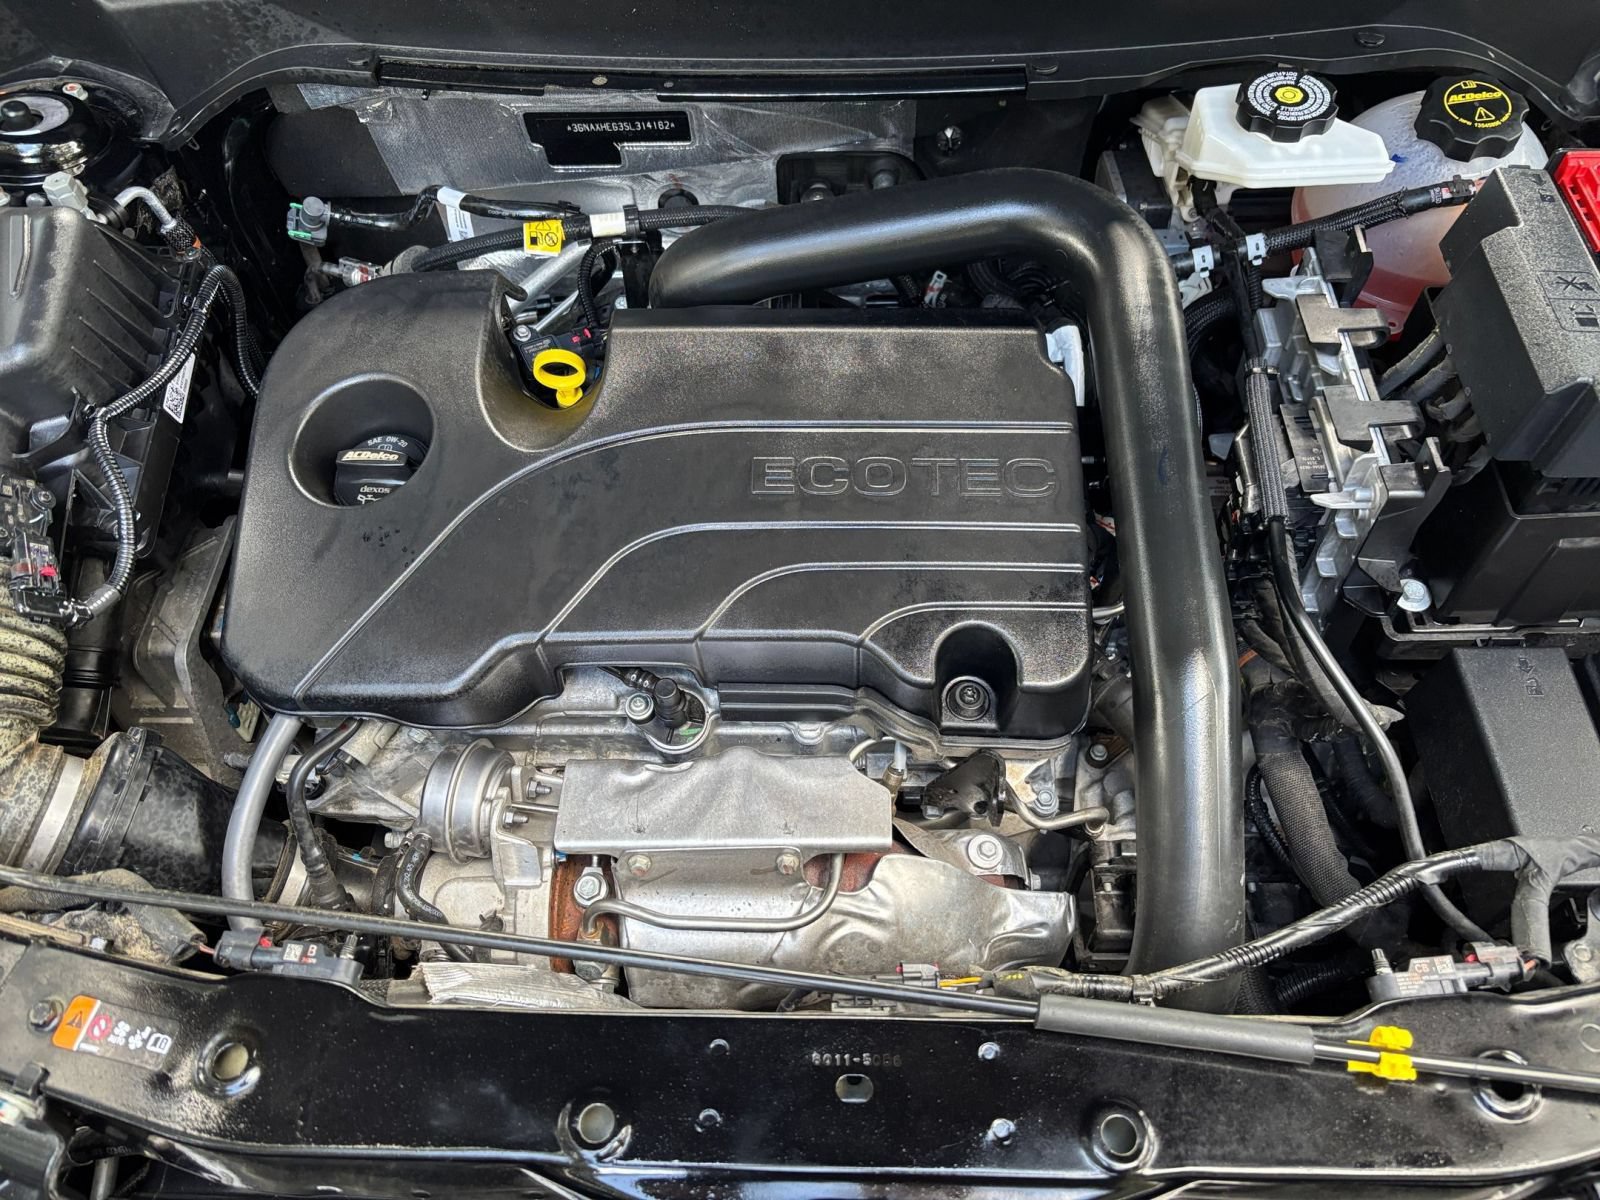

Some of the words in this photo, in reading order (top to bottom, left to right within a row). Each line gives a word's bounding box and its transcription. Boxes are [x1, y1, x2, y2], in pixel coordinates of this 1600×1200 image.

[1448, 91, 1502, 103] ACDelco
[367, 436, 382, 446] SAE
[386, 435, 408, 448] 0W-20
[341, 450, 399, 461] ACDelco
[752, 456, 1055, 498] ECOTEC
[360, 485, 391, 494] dexos
[307, 944, 317, 956] B
